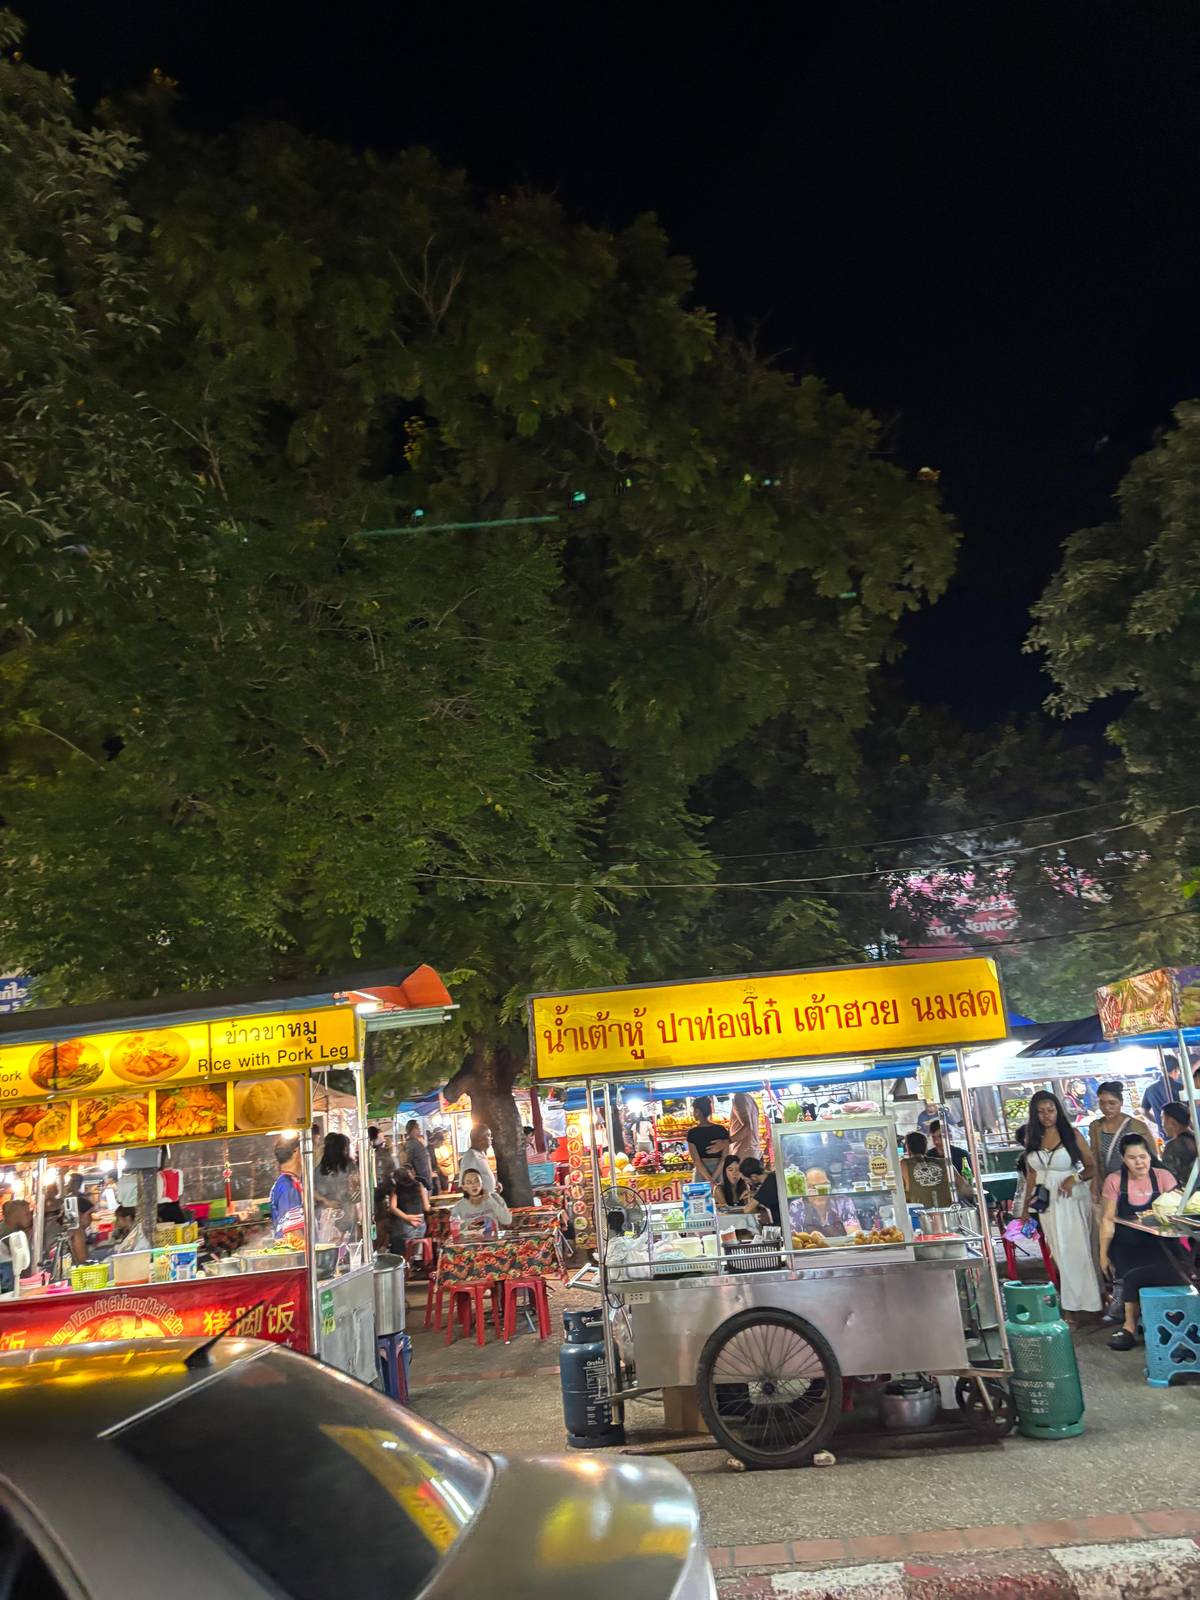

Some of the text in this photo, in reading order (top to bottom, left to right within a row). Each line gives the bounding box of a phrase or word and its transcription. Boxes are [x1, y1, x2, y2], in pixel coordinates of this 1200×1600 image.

[226, 1020, 317, 1044] ข้าวขาหมู
[543, 988, 998, 1060] น้ำเต้าหู้ ปาท่องโก๋ เต้าฮวย นมสด
[198, 1045, 349, 1072] Rice with Pork Leg
[0, 1070, 22, 1082] ork
[70, 1309, 97, 1327] Van
[93, 1298, 109, 1317] At
[107, 1294, 147, 1316] Chiang
[144, 1297, 167, 1321] Mai
